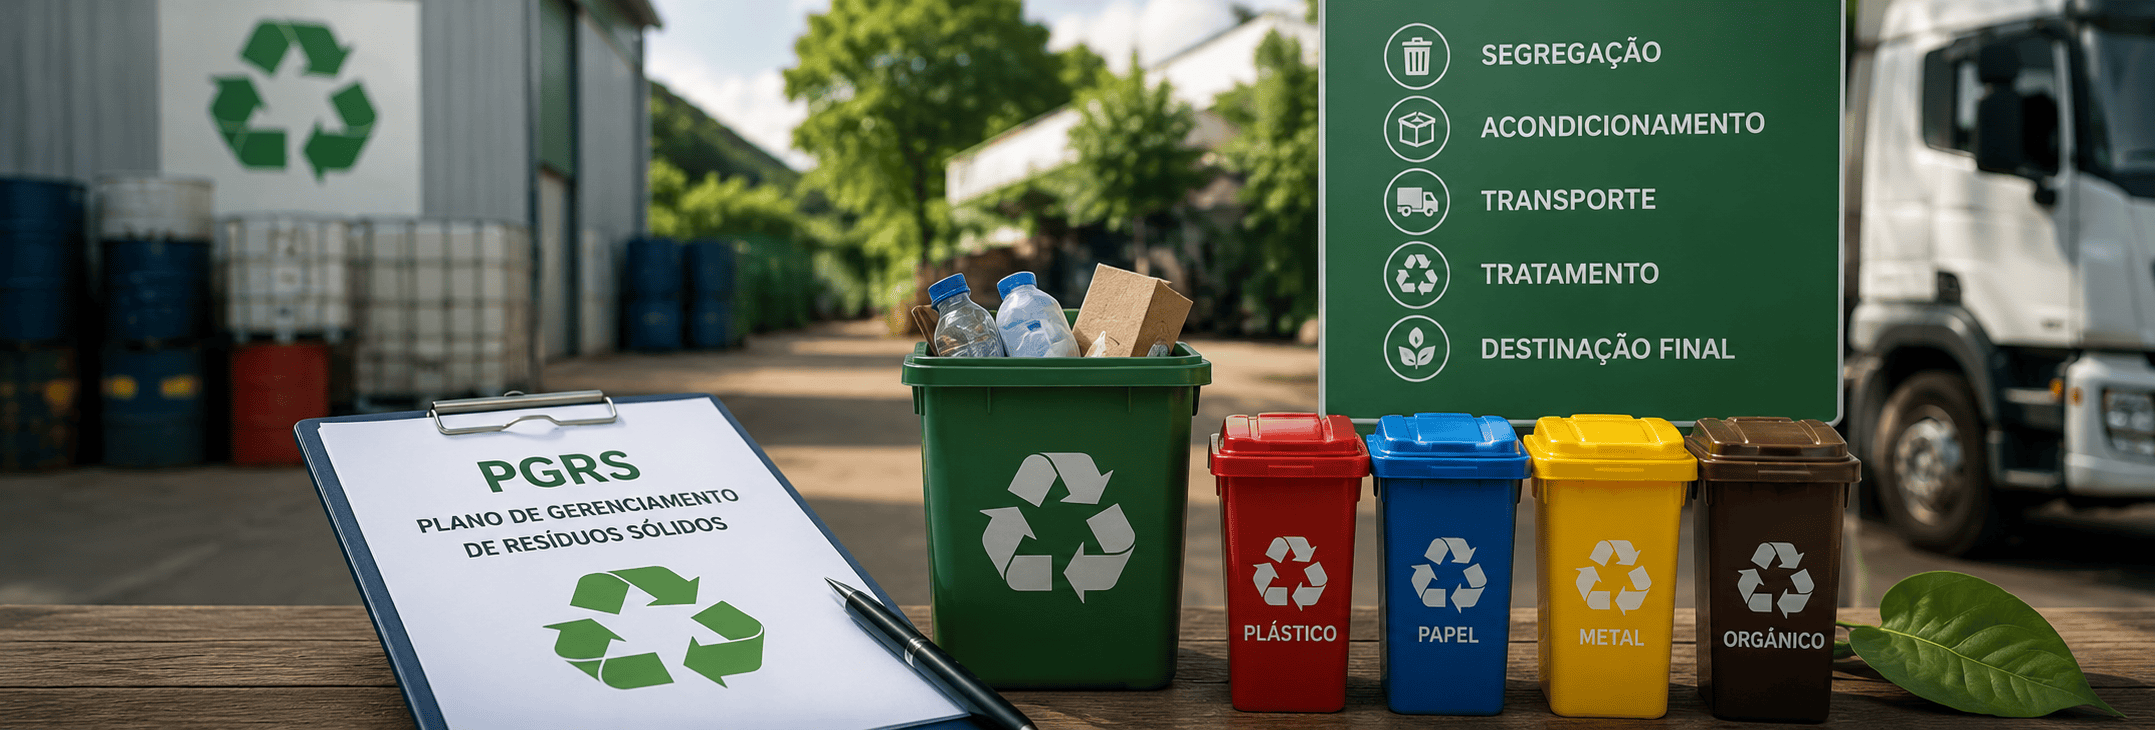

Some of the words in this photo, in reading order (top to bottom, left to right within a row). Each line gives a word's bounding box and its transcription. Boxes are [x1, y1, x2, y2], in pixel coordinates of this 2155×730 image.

[1481, 36, 1662, 70] SEGREGAÇÃO
[1480, 111, 1765, 139] ACONDICIONAMENTO
[1480, 188, 1656, 212] TRANSPORTE
[1480, 262, 1659, 285] TRATAMENTO
[1481, 332, 1651, 366] DESTINAÇÃO
[1659, 337, 1736, 360] FINAL
[476, 450, 641, 493] PGRS
[415, 511, 504, 534] PLANO
[507, 507, 544, 524] DE
[546, 488, 740, 520] GERENCIAMENTO
[462, 539, 500, 559] DE
[504, 526, 624, 554] RESÍDUOS
[626, 516, 729, 540] SÓLIDOS
[1244, 620, 1337, 642] PLÁSTICO
[1418, 625, 1480, 644] PAPEL
[1579, 628, 1645, 647] METAL
